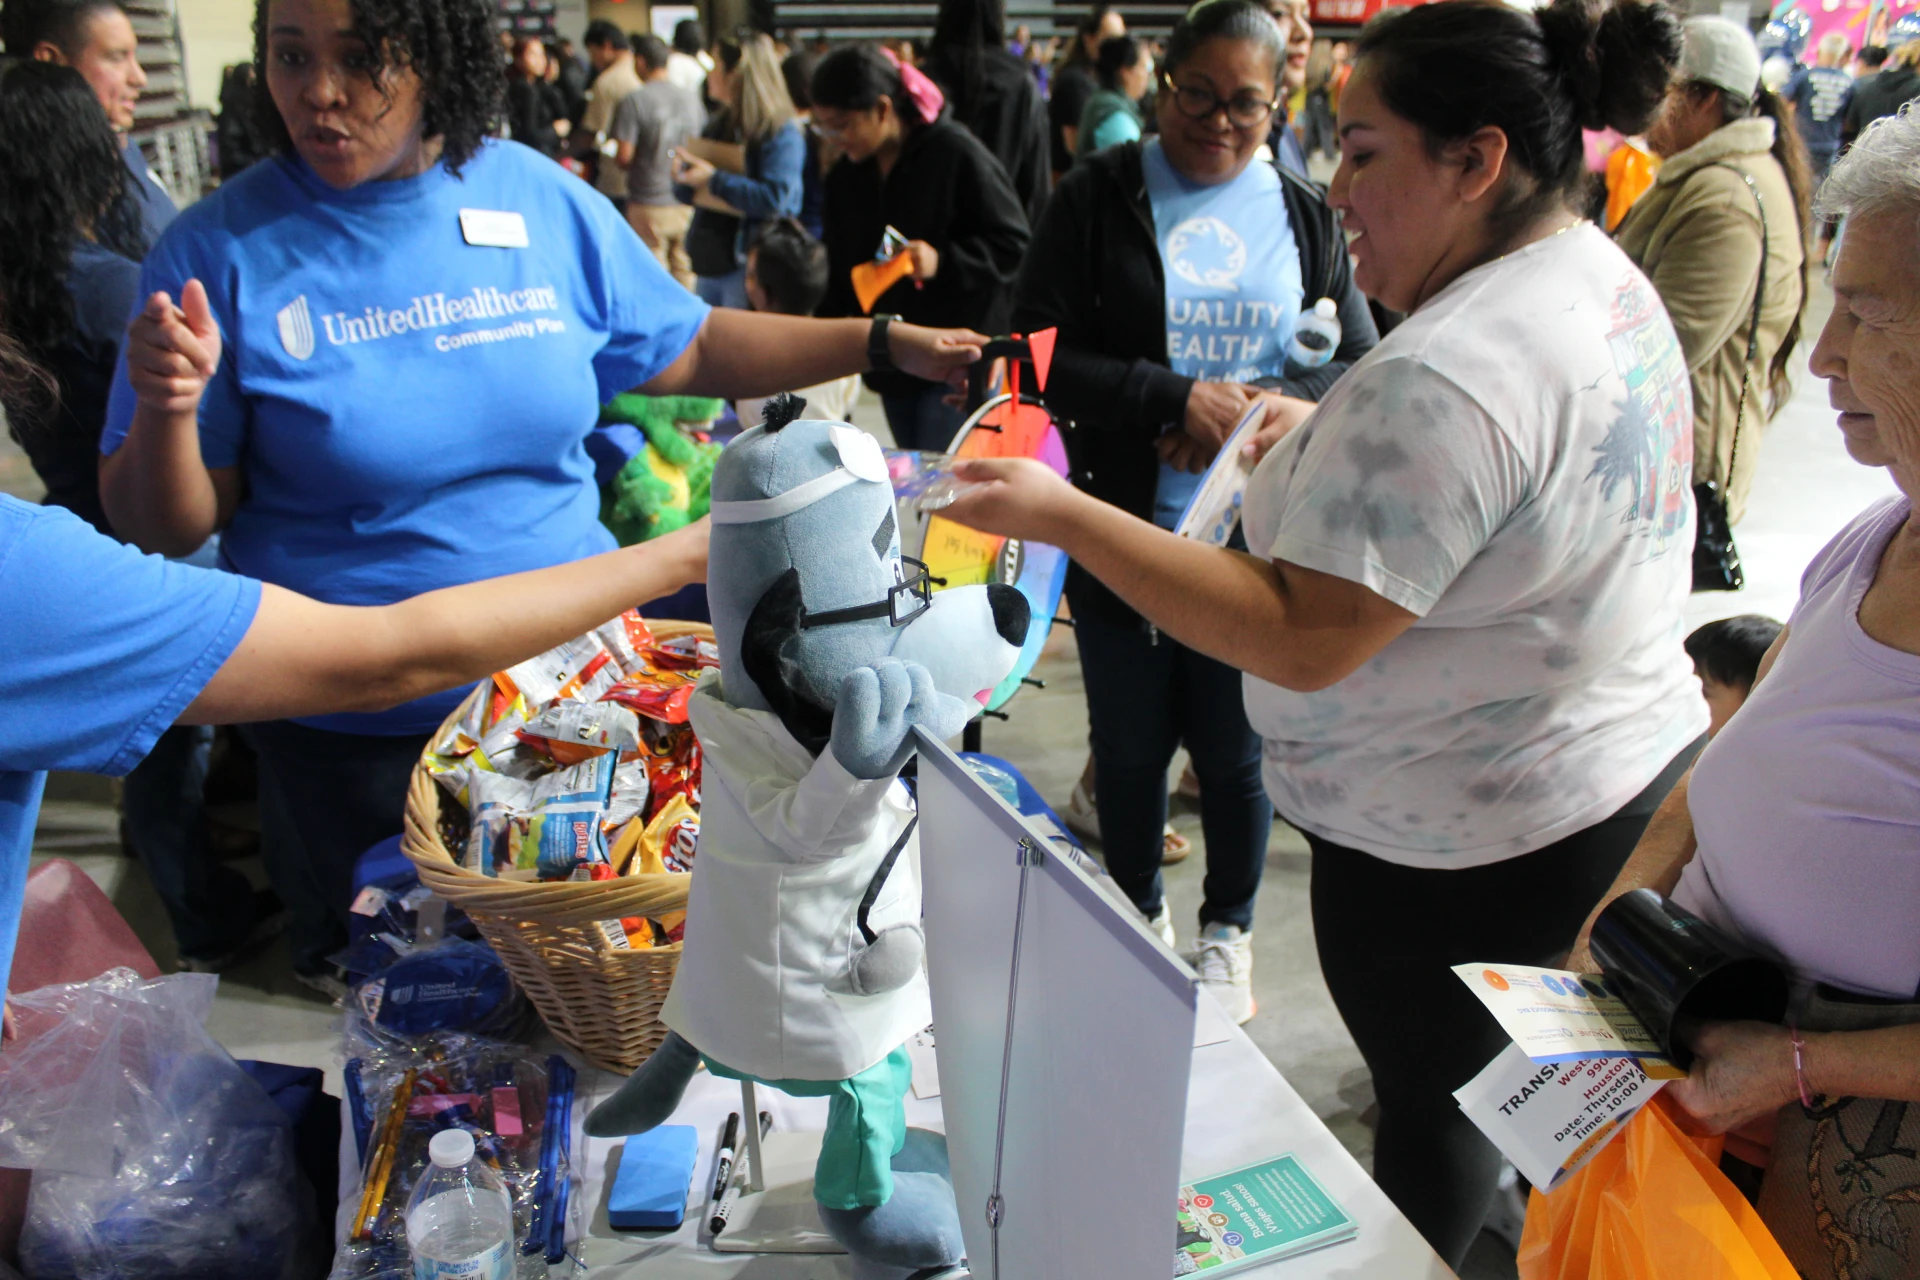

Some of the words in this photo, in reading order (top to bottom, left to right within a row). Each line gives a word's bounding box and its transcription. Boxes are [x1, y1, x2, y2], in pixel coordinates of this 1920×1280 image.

[321, 285, 560, 346] UnitedHealthcare
[1168, 298, 1285, 329] UALITY
[434, 319, 534, 352] Community
[535, 317, 566, 335] Plan
[1168, 332, 1264, 361] EALTH
[572, 821, 589, 859] RUFFLES
[663, 818, 700, 872] itos
[1583, 1058, 1629, 1100] Houston
[1586, 1057, 1613, 1079] 990
[1554, 1114, 1585, 1142] Date:
[1584, 1068, 1639, 1114] Thursday,
[1572, 1111, 1606, 1140] Time:
[1605, 1082, 1639, 1112] 10:00
[1218, 1188, 1244, 1212] salud.
[1231, 1182, 1259, 1208] sanos!
[1239, 1211, 1265, 1239] Buena
[1254, 1205, 1283, 1234] ¡Viajes
